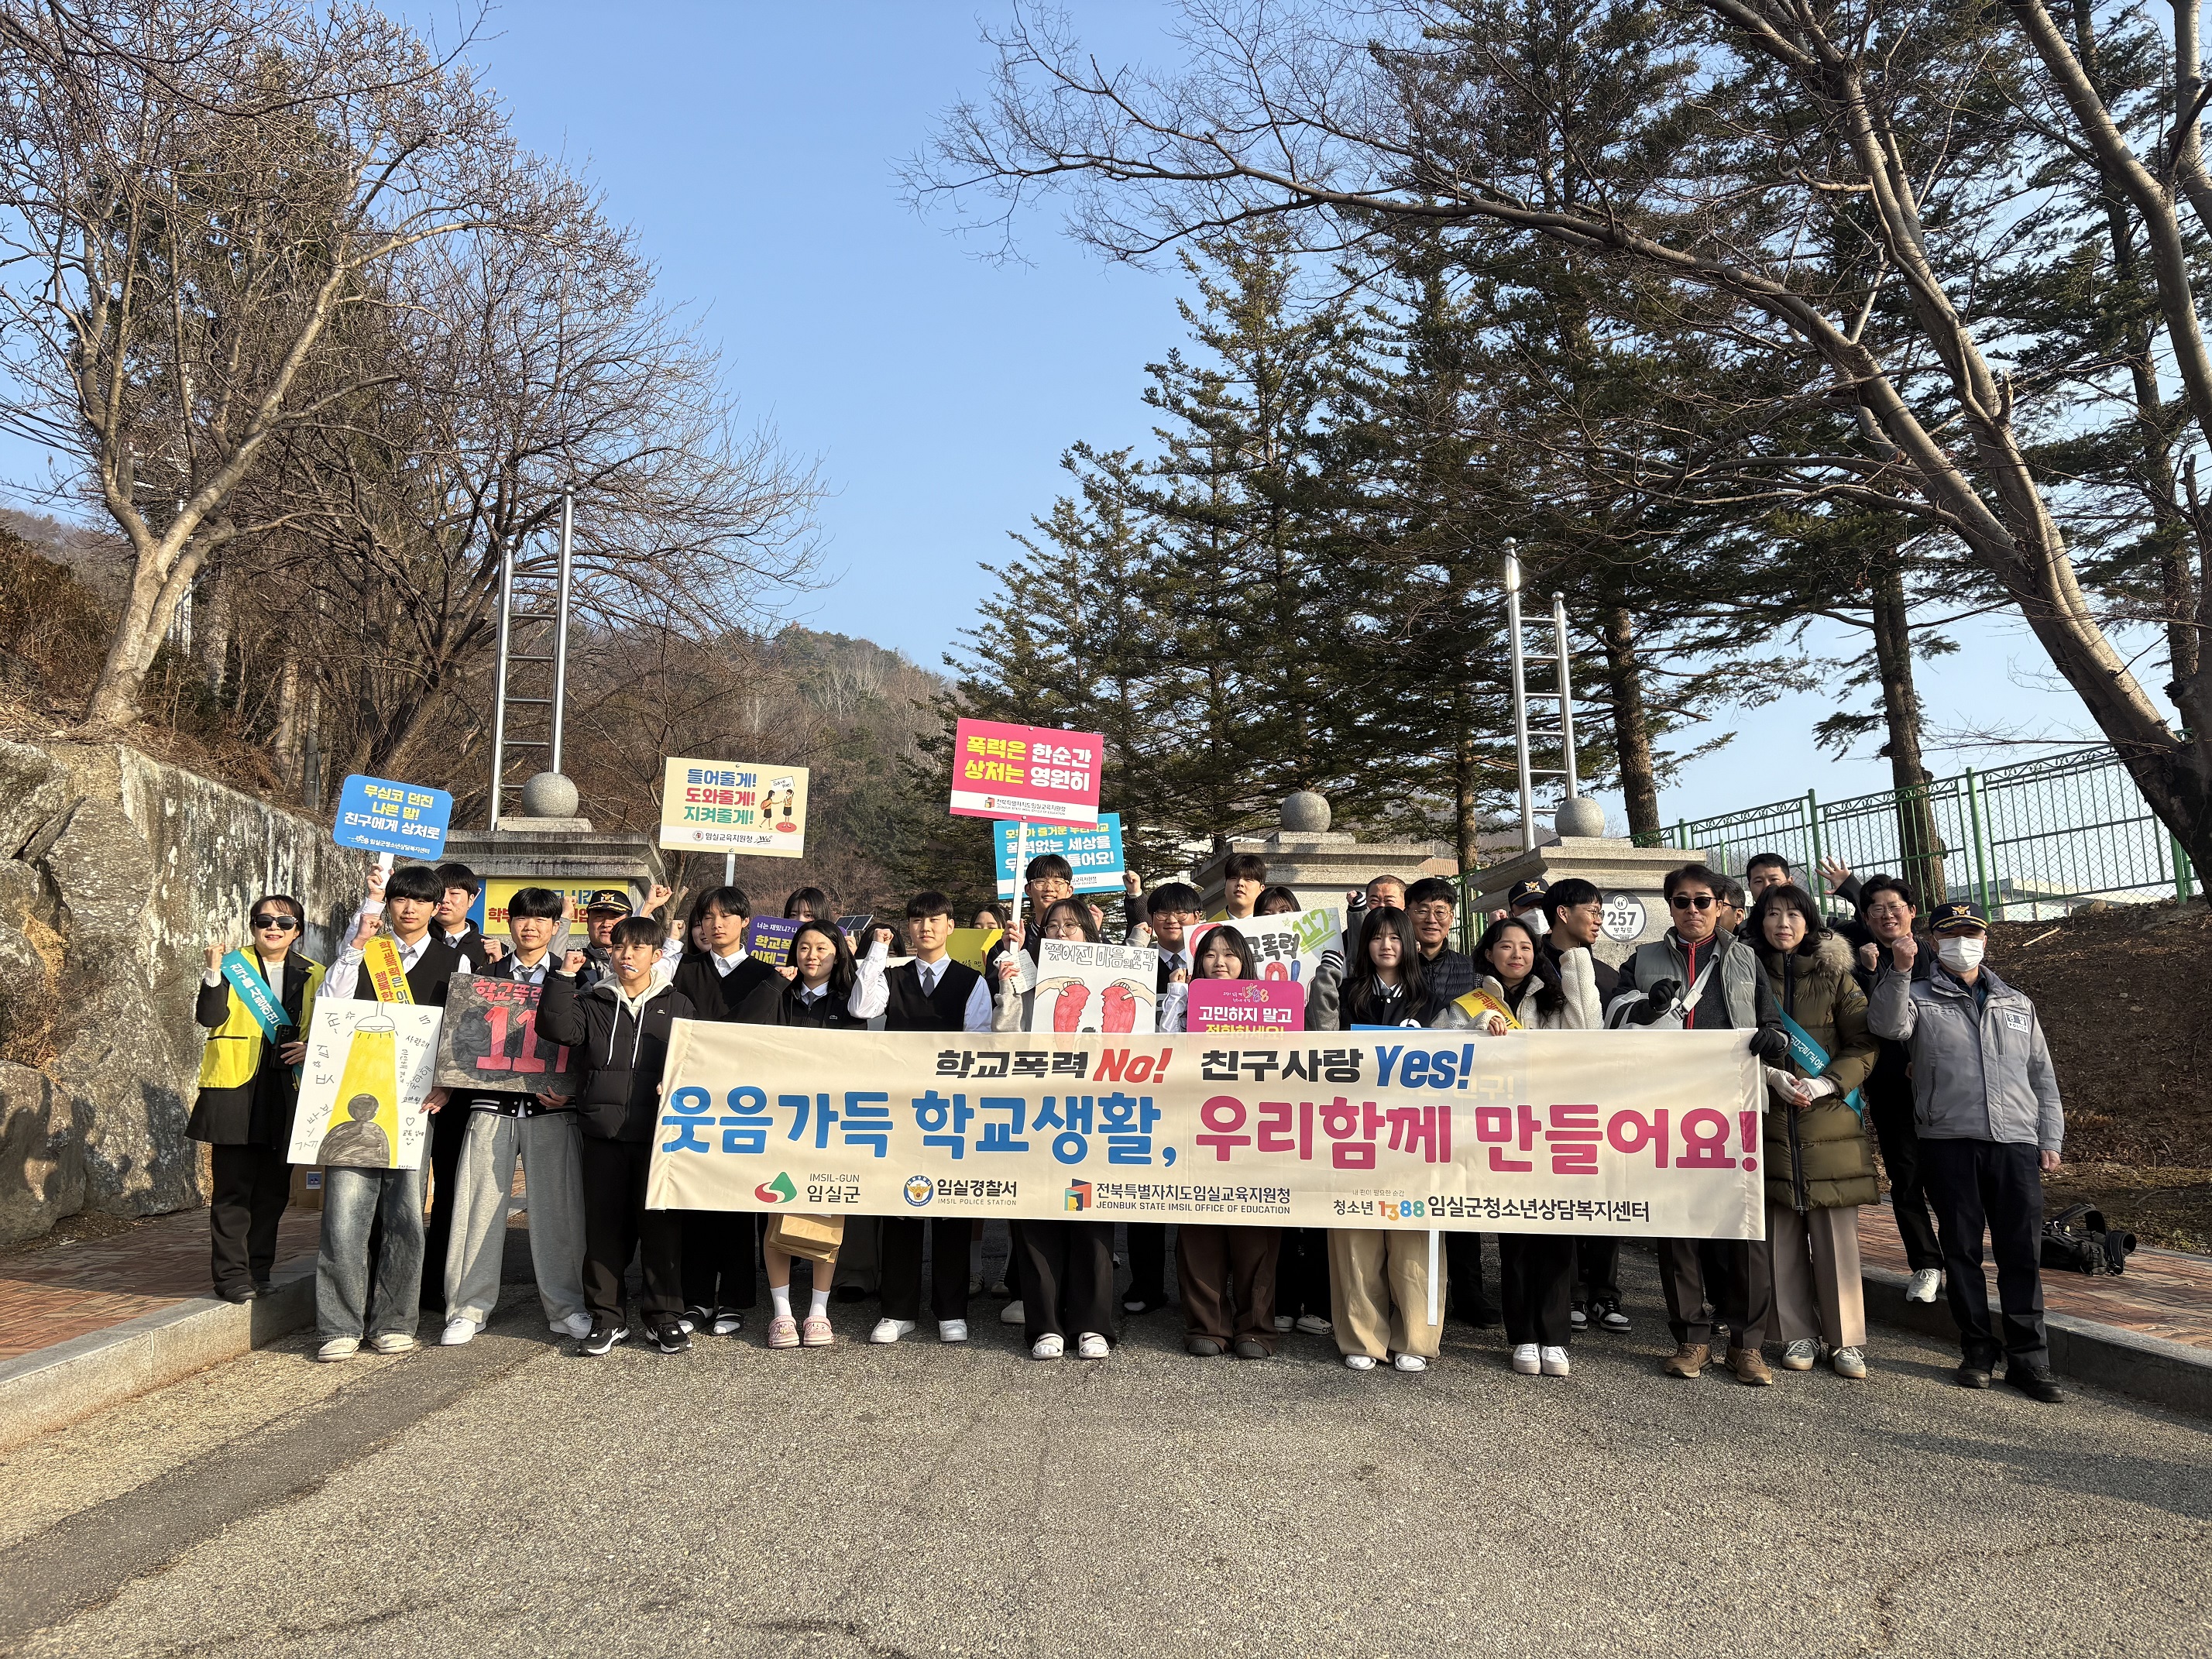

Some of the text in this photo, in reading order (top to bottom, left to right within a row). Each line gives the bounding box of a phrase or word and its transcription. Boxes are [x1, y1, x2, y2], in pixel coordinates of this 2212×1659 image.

[966, 735, 1092, 769] 폭력은 한순간
[687, 768, 757, 788] 들어줄게!
[964, 759, 1091, 792] 상처는 영원히
[363, 784, 434, 809] 무심코 던진
[685, 787, 756, 806] 도와줄게!
[372, 801, 421, 821] 나쁜 말!
[683, 805, 754, 825] 지켜줄게!
[344, 812, 441, 840] 친구에게 상처로
[705, 832, 753, 843] 임실교육지원청
[1068, 835, 1111, 851] 세상을
[1292, 908, 1330, 947] 117
[1607, 911, 1637, 926] 257
[1245, 933, 1300, 963] 교폭력
[1133, 950, 1156, 971] 조각
[1242, 984, 1269, 1002] 1388
[1198, 1006, 1293, 1023] 고민하지 말고
[936, 1043, 1475, 1090] 학교폭력 No! 친구사랑 Yes!
[661, 1085, 1758, 1176] 웃음가득 학교생활, 우리함께 만들어요!
[809, 1173, 860, 1183] IMSIL-GUN
[806, 1184, 861, 1204] 임실군
[936, 1179, 1018, 1198] 임실경찰서
[1096, 1183, 1291, 1205] 전북특별자치도임실교육지원청
[1139, 1202, 1166, 1211] STATE
[1168, 1203, 1193, 1211] IMSIL
[1194, 1204, 1224, 1213] OFFICE
[1227, 1204, 1238, 1213] OF
[1241, 1205, 1290, 1214] EDUCATION
[1333, 1196, 1650, 1223] 청소년 1388 임실군청소년상담복지센터
